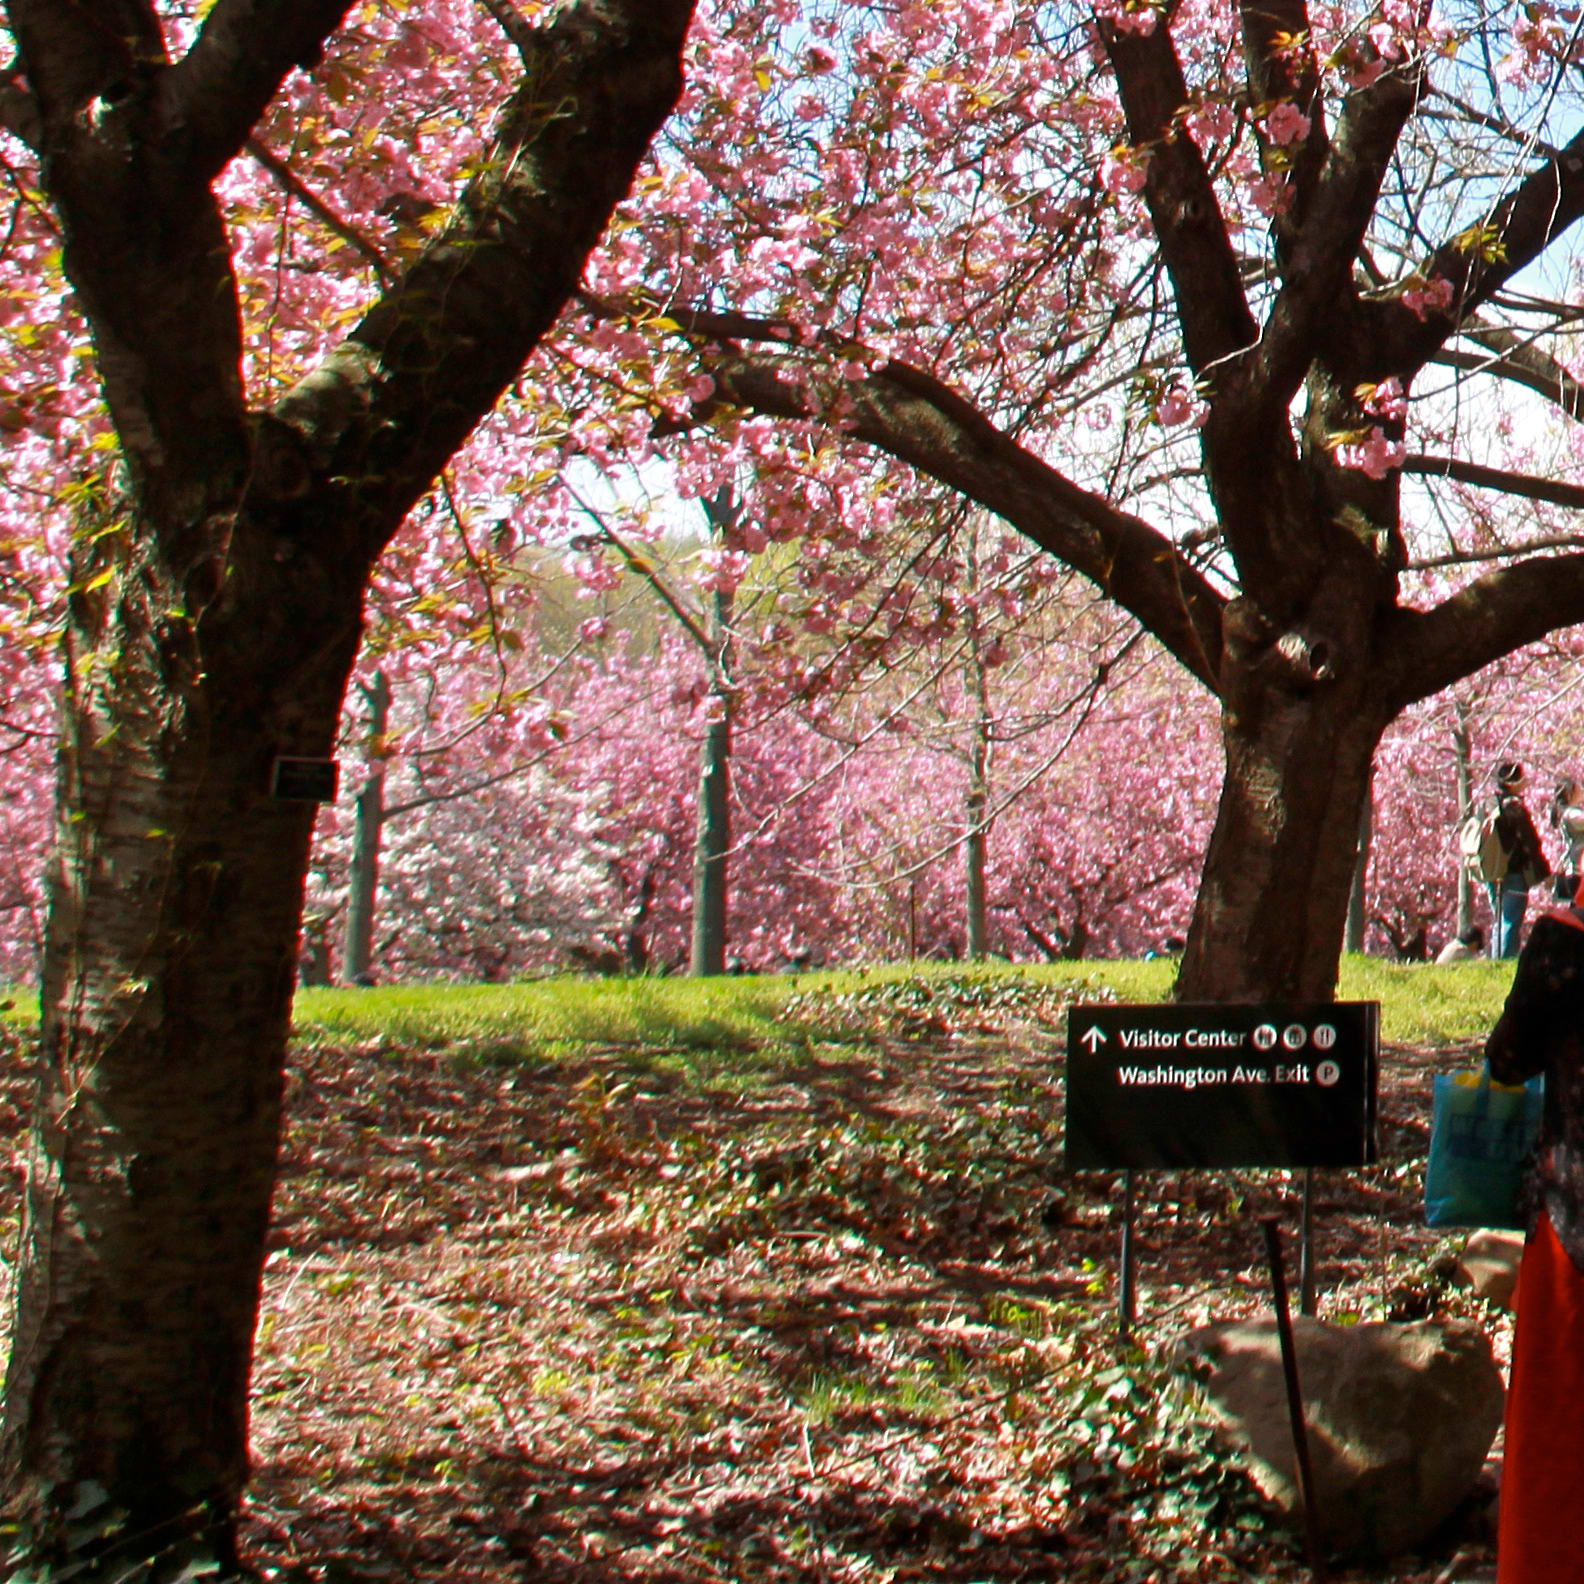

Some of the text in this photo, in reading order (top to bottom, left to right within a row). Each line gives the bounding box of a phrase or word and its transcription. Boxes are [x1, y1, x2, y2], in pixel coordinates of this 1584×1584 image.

[1119, 1027, 1247, 1048] Visitor Center
[1118, 1065, 1227, 1089] Washington
[1231, 1065, 1271, 1083] Ave.
[1275, 1064, 1310, 1083] Exit
